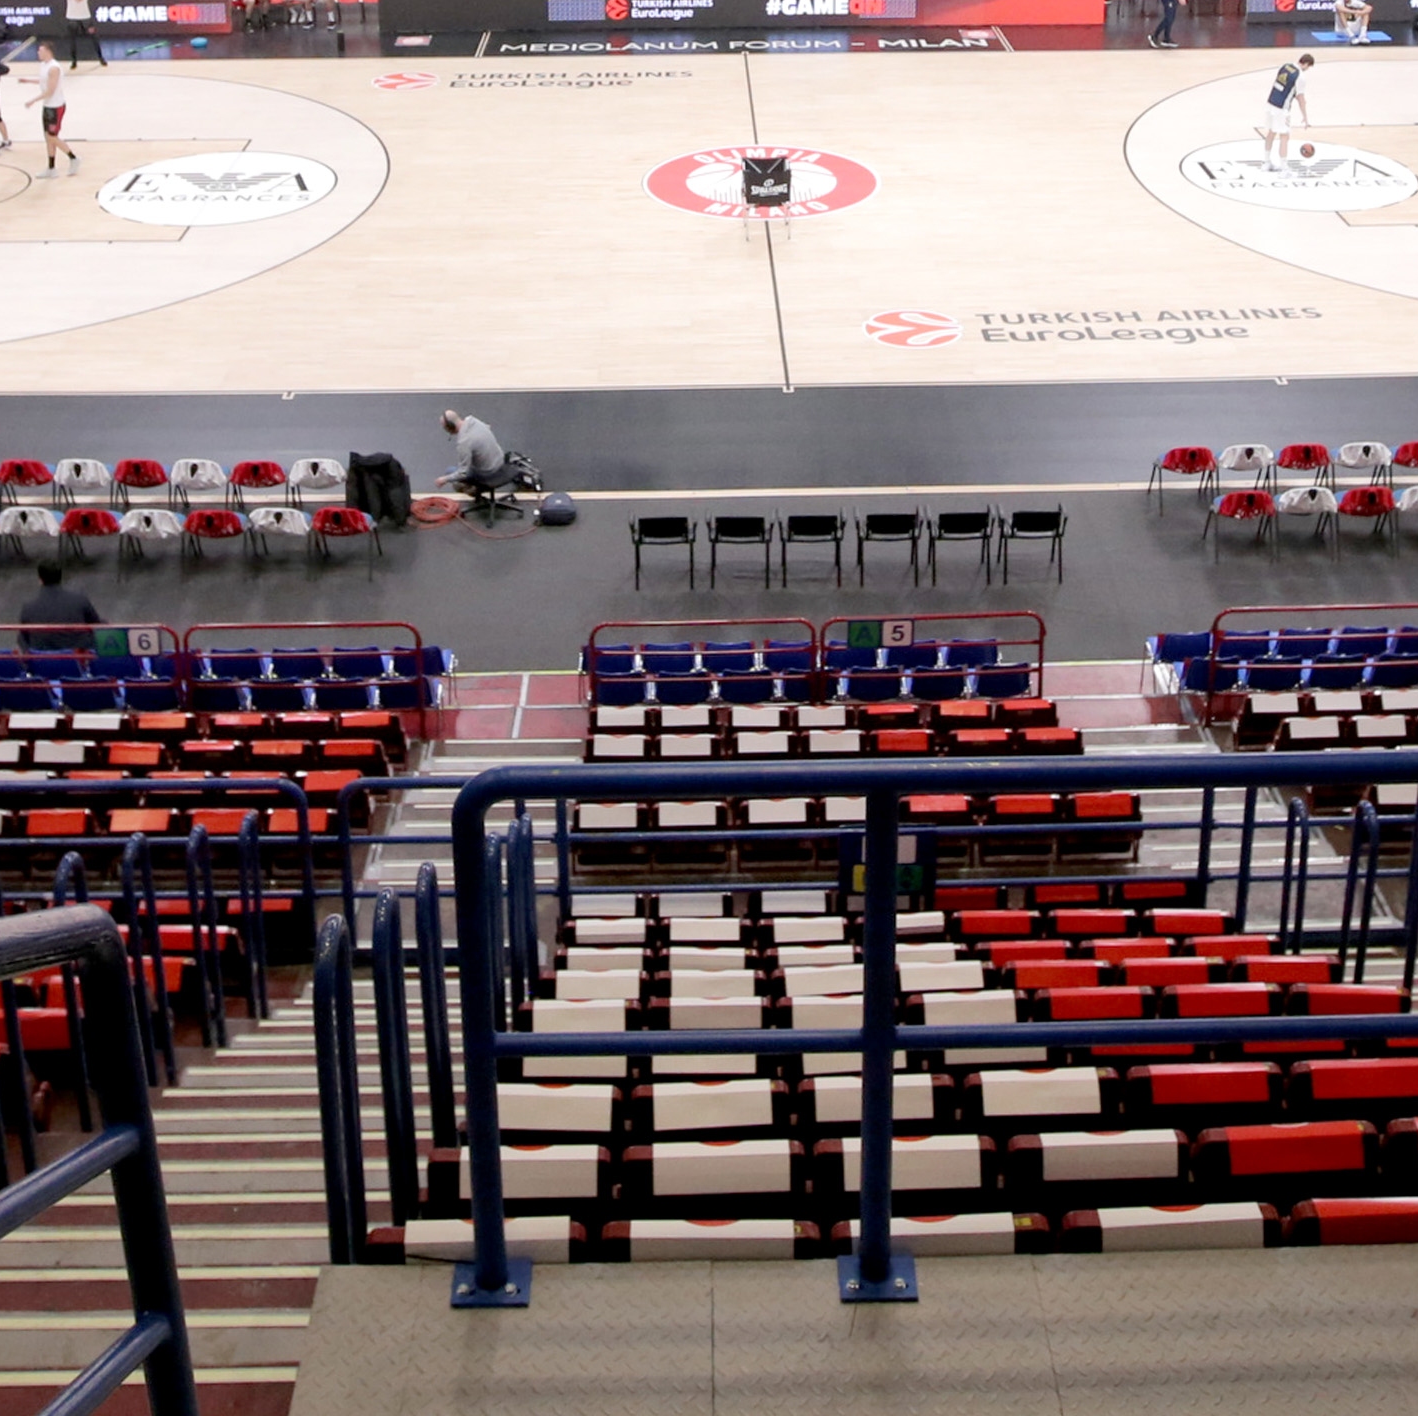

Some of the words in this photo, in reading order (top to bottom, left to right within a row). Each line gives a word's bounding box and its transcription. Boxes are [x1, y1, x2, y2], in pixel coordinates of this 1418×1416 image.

[15, 6, 51, 16] AIRLINES
[631, 7, 694, 20] EuroLeague
[499, 40, 718, 53] MEDIOLANUM
[729, 39, 842, 50] FORUM
[878, 38, 989, 49] MILAN
[454, 72, 568, 80] TURKISH
[577, 70, 694, 79] AIRLINES
[449, 79, 633, 90] EuroLeague
[693, 147, 822, 165] OLIMPIA
[750, 184, 789, 196] SPALDING
[109, 194, 311, 203] FRAGRANCES
[703, 200, 830, 218] MILANO
[975, 310, 1144, 326] TURKISH
[1157, 307, 1324, 322] AIRLINES
[981, 324, 1251, 344] EuroLeague
[890, 624, 905, 642] 5
[137, 633, 151, 651] 6
